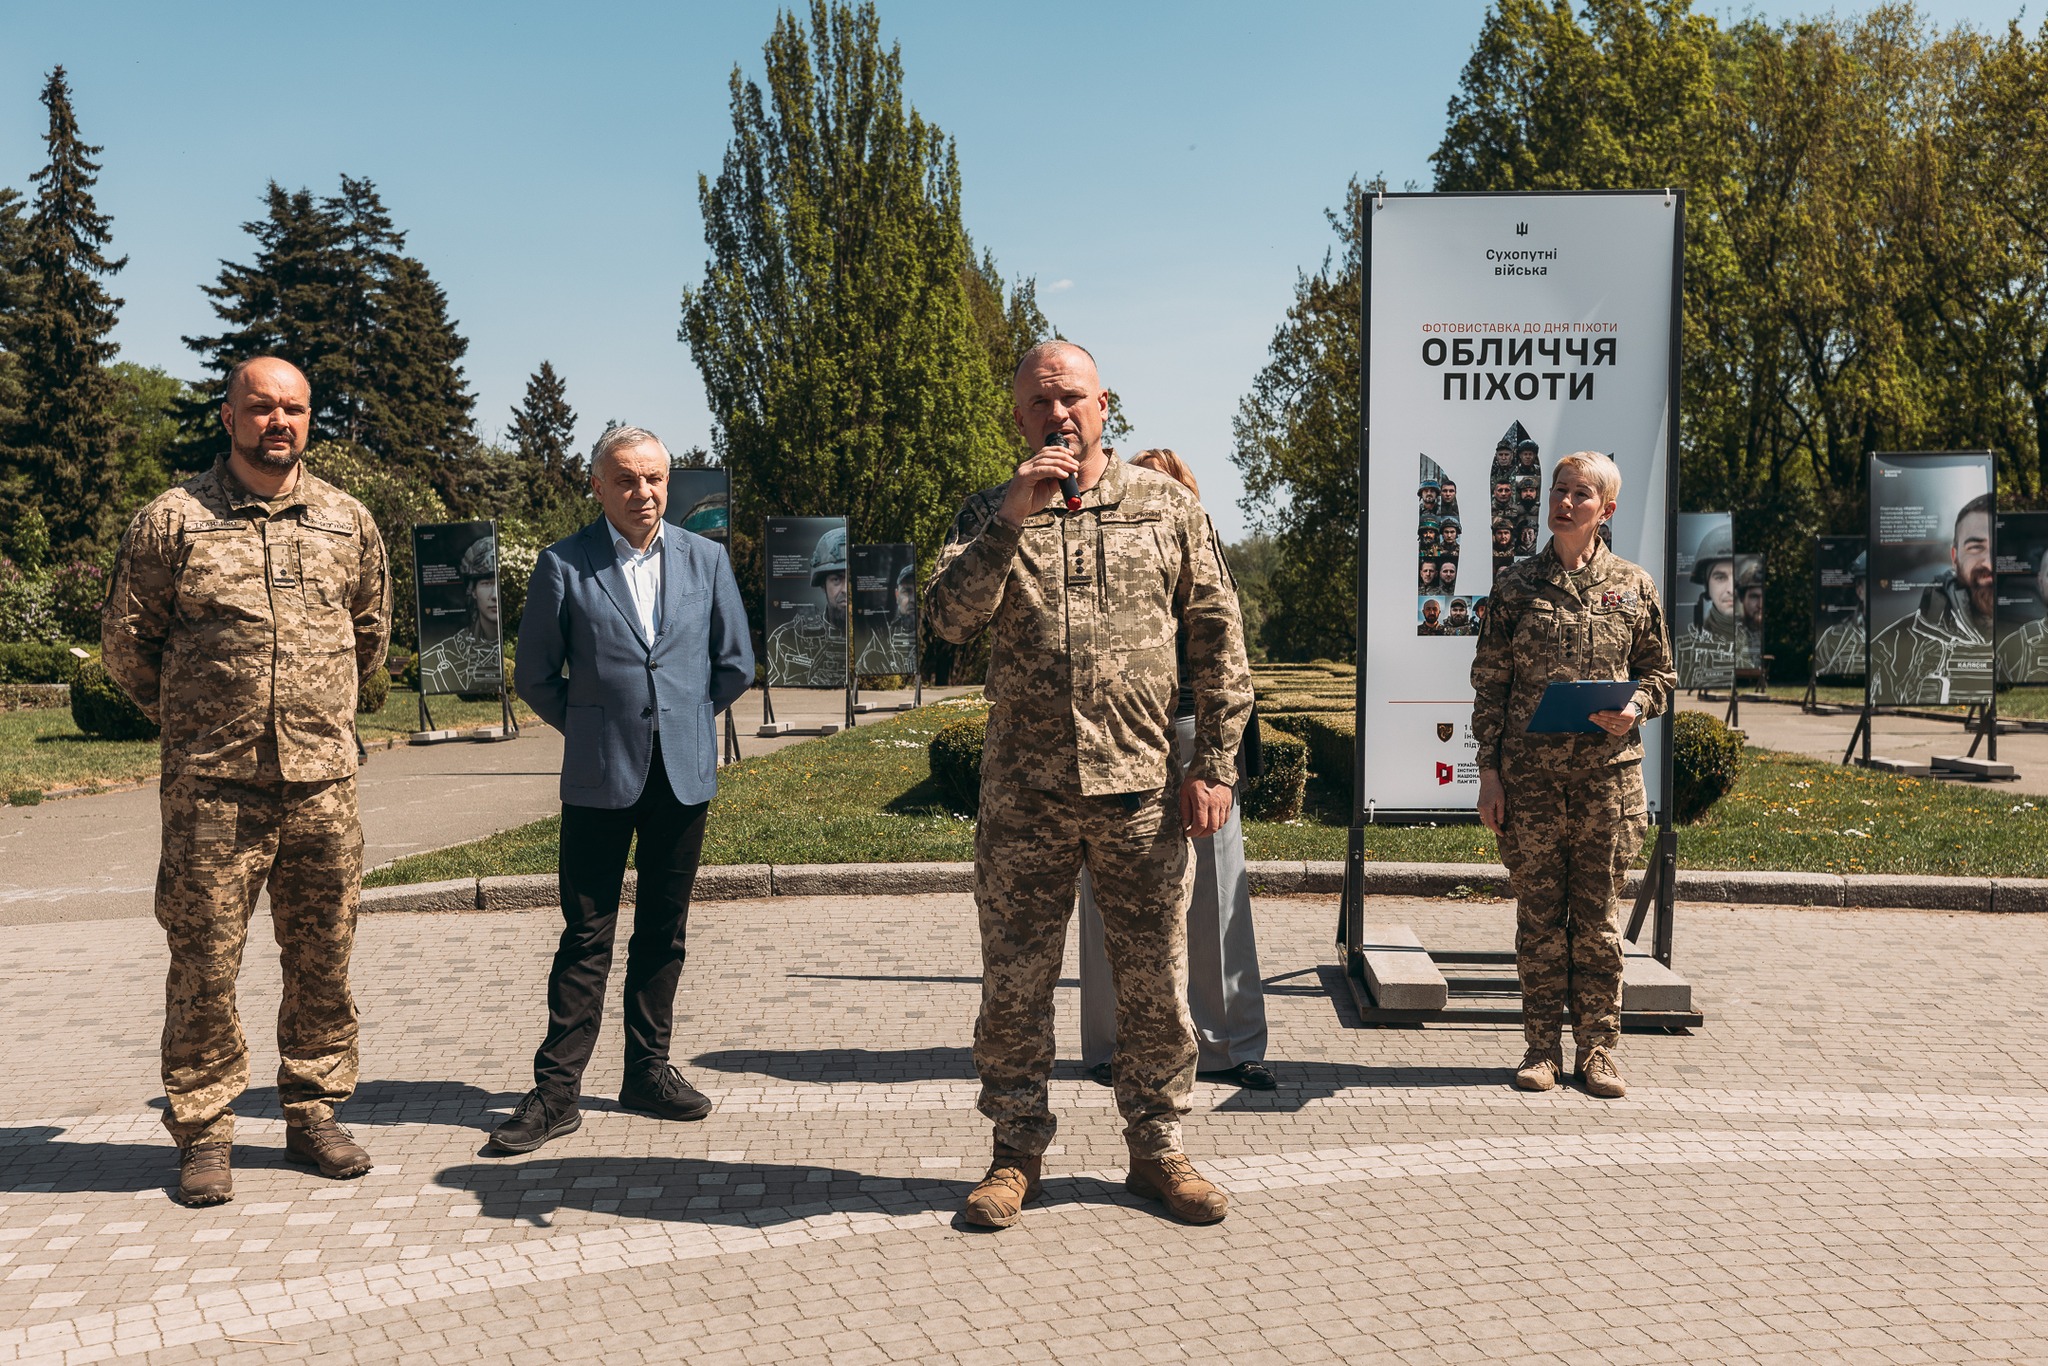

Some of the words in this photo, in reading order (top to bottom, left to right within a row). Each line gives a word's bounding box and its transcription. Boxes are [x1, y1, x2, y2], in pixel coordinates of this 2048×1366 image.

[1485, 247, 1558, 262] Сухопутні
[1494, 264, 1548, 277] війська
[1422, 322, 1520, 333] ФОТОВИСТАВКА
[1523, 322, 1541, 334] ДО
[1543, 322, 1569, 334] ДНЯ
[1573, 322, 1618, 333] ПІХОТИ
[1421, 337, 1617, 367] ОБЛИЧЧЯ
[1443, 372, 1594, 401] ПІХОТИ
[1464, 741, 1480, 749] підт
